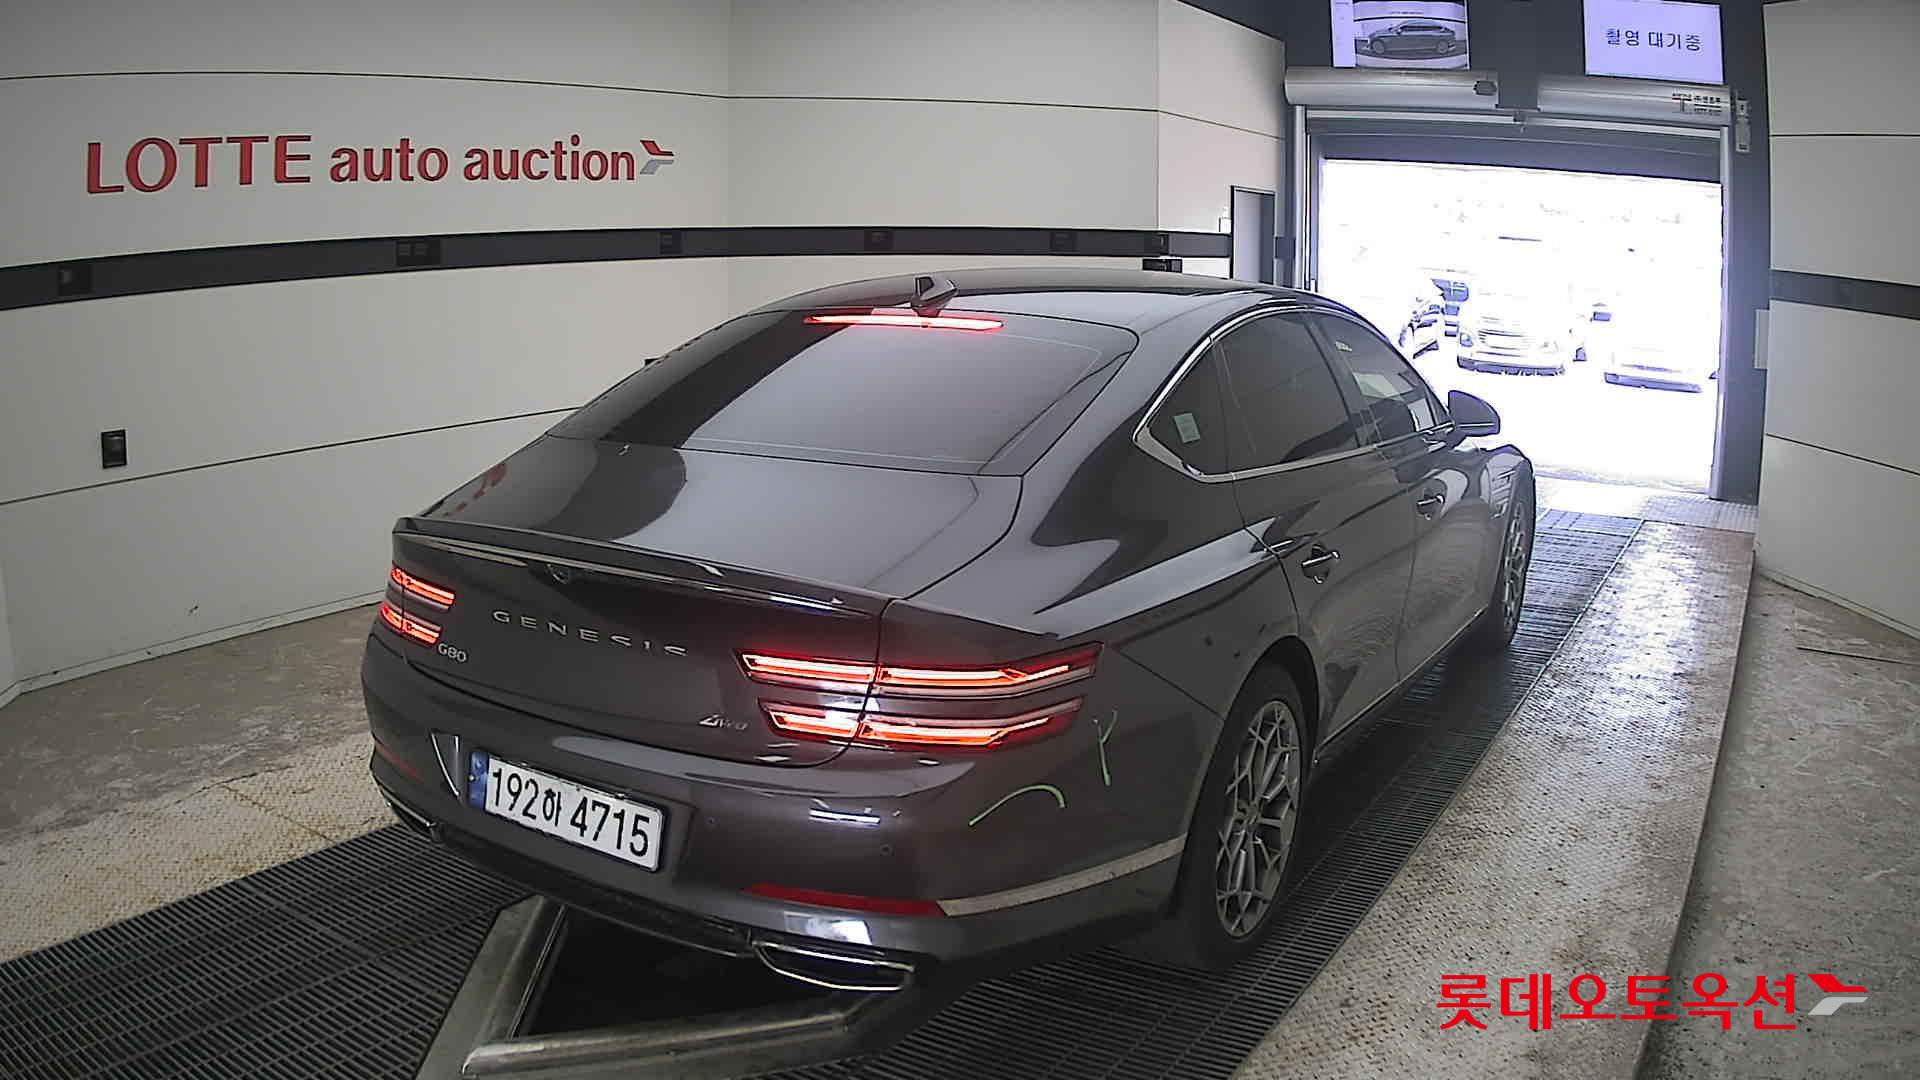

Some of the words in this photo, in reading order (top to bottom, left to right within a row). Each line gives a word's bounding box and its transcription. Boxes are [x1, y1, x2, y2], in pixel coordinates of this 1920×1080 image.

[1648, 31, 1700, 51] 대기중
[86, 134, 311, 194] LOTTE
[330, 138, 448, 183] auto
[463, 134, 635, 182] auction
[438, 643, 467, 662] G80
[493, 611, 687, 656] GENESIS
[493, 768, 562, 826] 192하
[570, 796, 650, 857] 4715
